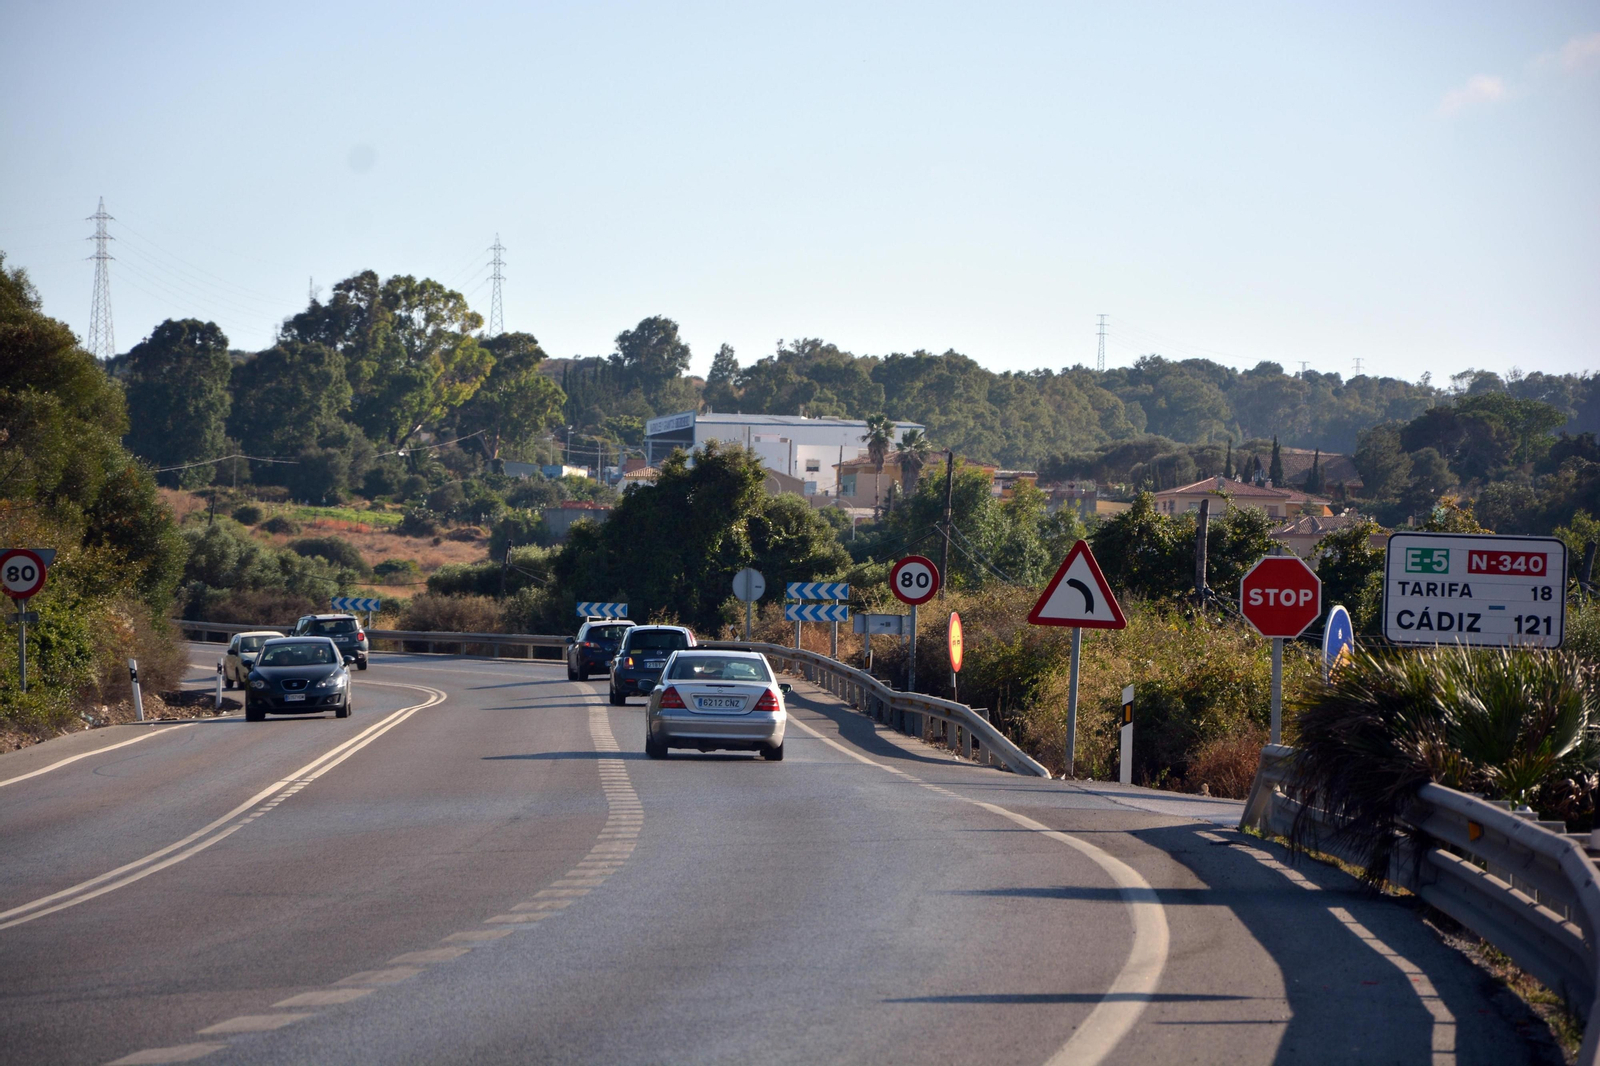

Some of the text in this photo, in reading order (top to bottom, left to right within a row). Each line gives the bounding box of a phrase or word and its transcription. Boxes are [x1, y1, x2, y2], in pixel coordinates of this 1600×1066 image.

[1406, 550, 1448, 572] E-5
[1471, 554, 1543, 573] N-340
[6, 565, 35, 582] 80
[901, 571, 930, 588] 80
[1248, 588, 1313, 607] STOP
[1398, 581, 1553, 601] TARIFA 18
[1396, 606, 1552, 635] CÁDIZ 121
[703, 698, 740, 708] 6212 CNZ
